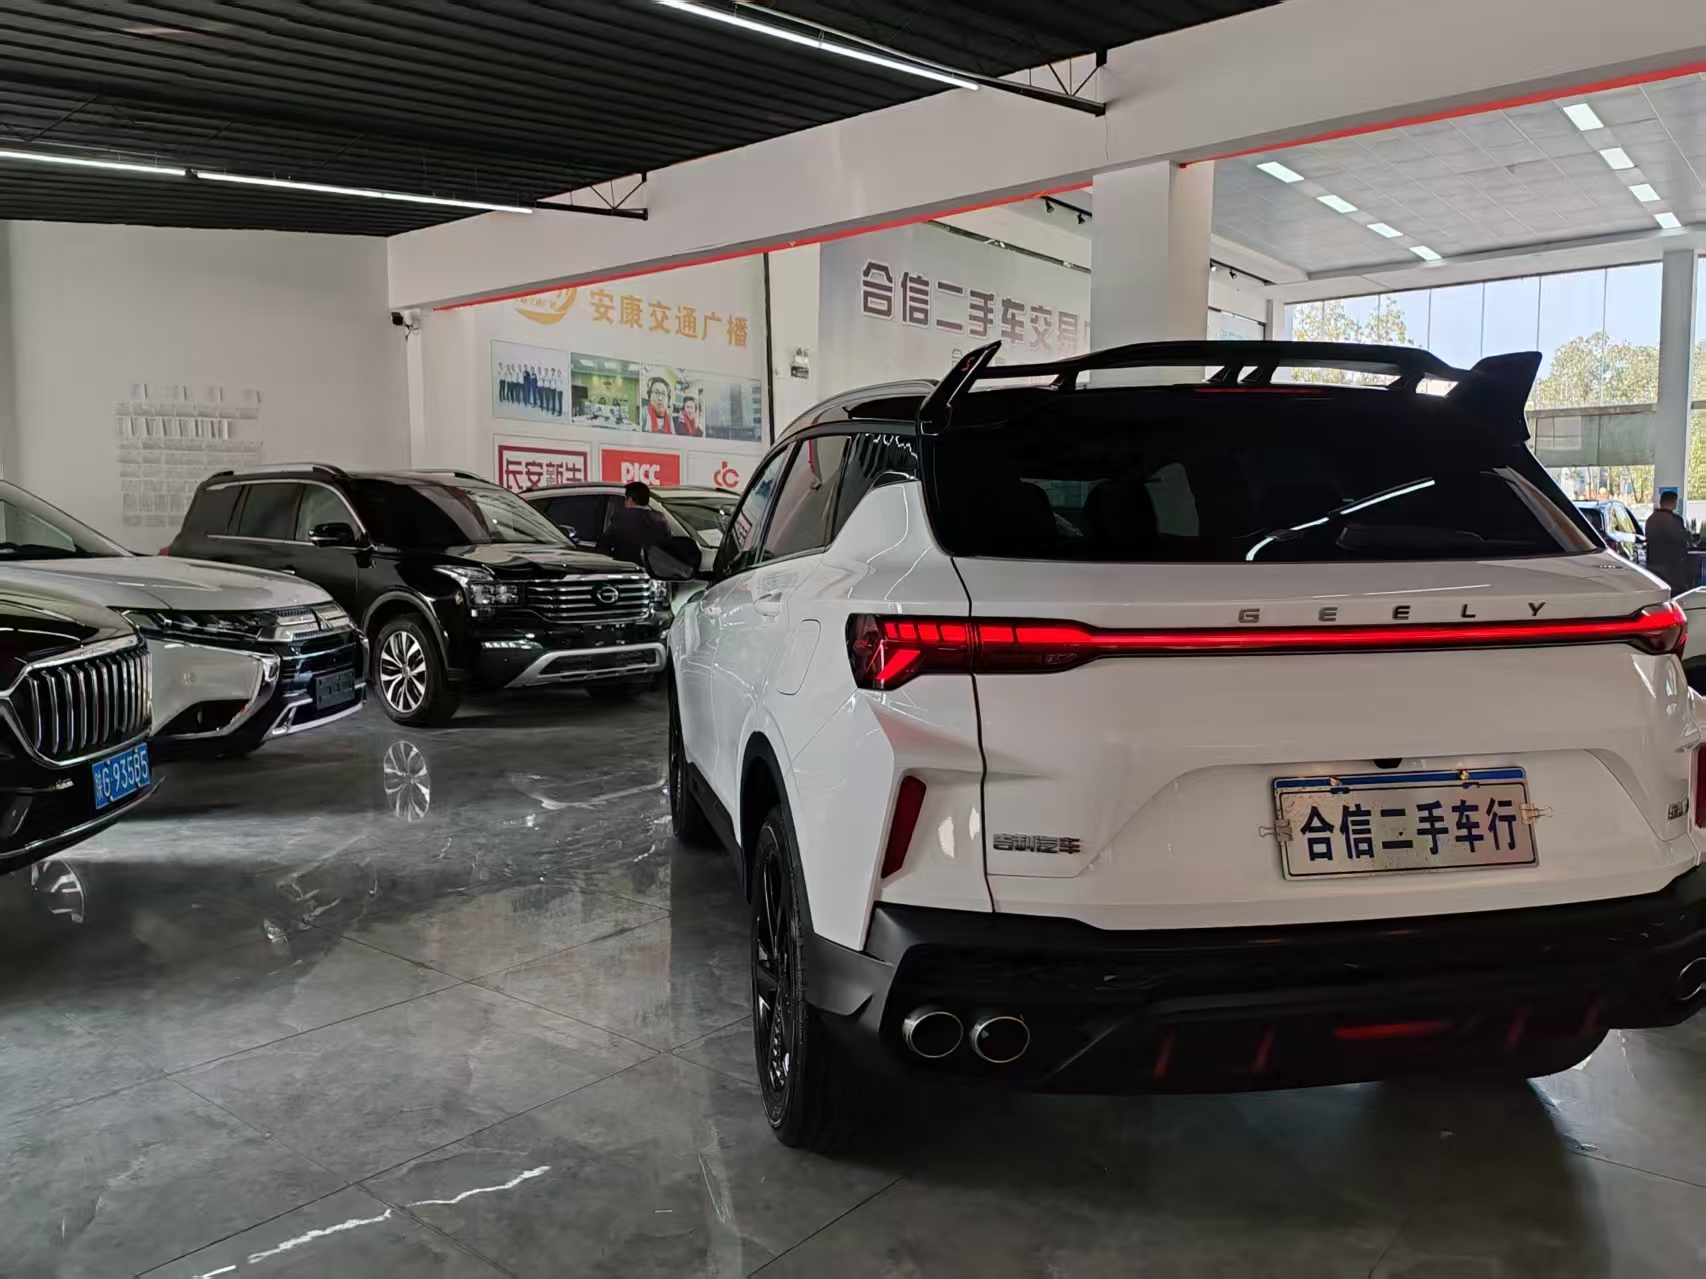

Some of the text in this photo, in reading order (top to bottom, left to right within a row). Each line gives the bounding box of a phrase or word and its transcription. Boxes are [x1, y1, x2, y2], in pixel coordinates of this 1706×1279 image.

[588, 288, 748, 347] 安康交通广播
[862, 260, 1090, 352] 合信二手车交易
[620, 462, 661, 486] PICC
[1238, 601, 1546, 624] GEELY
[993, 833, 1081, 854] 吉利汽车
[1300, 798, 1517, 861] 合信二手车行
